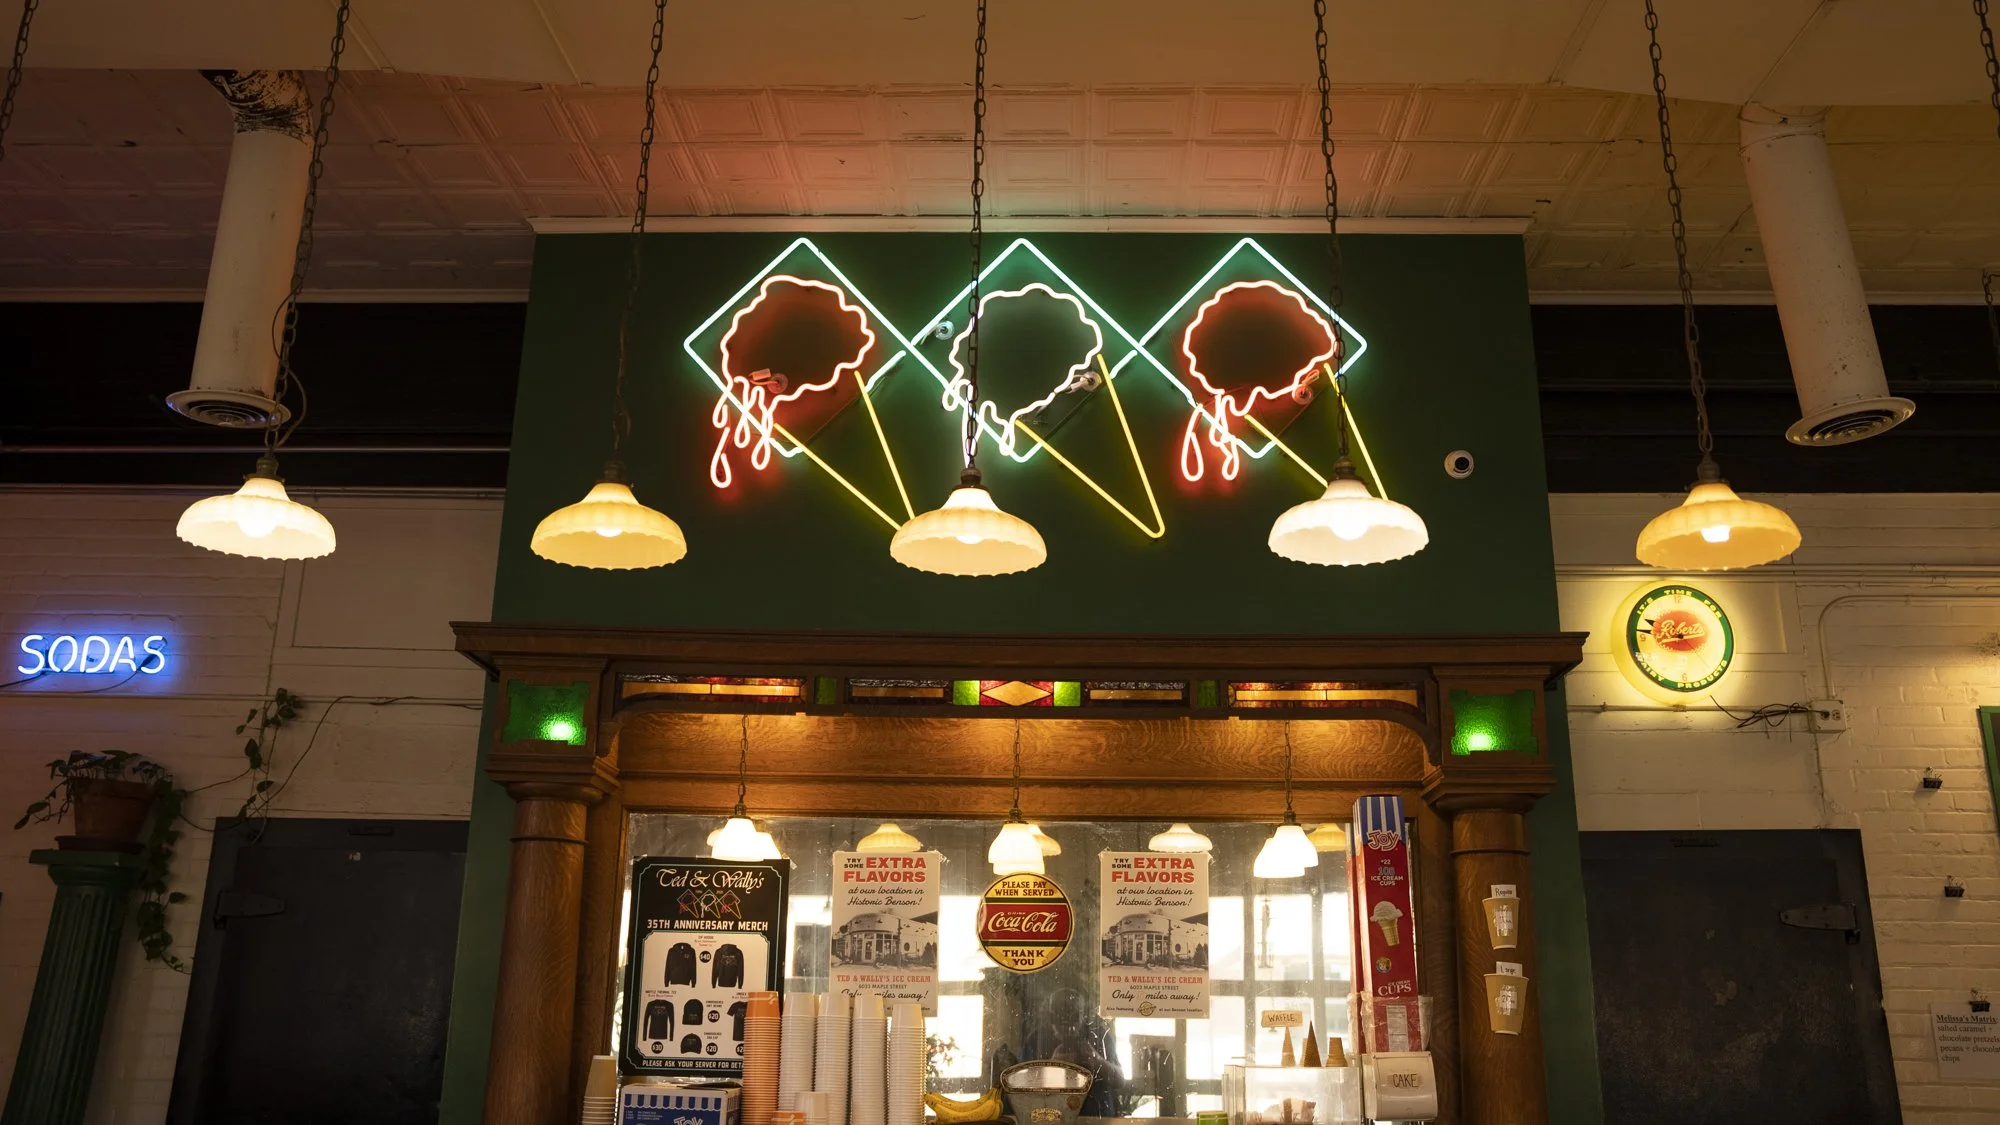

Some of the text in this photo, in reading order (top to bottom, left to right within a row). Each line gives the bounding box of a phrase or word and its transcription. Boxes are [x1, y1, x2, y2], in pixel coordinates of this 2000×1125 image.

[1636, 589, 1722, 619] IT'S TIME FOR
[1640, 634, 1647, 642] 9
[18, 634, 168, 675] SODAS
[1677, 660, 1728, 689] PRODUCTS
[866, 857, 926, 868] EXTRA
[1134, 857, 1194, 869] EXTRA
[656, 868, 764, 894] Ted & Wally's
[844, 871, 926, 882] FLAVORS
[1112, 871, 1194, 883] FLAVORS
[877, 886, 913, 894] location
[1147, 886, 1182, 895] location
[848, 896, 922, 906] Historic Benson!
[1116, 896, 1192, 906] Historic Benson!
[647, 919, 768, 931] 35TH ANNIVERSARY MERCH
[988, 911, 1060, 933] Coca-Cola
[700, 952, 711, 960] $40
[1002, 949, 1045, 957] THANK
[1013, 958, 1034, 966] YOU
[1164, 976, 1176, 984] ICE
[1378, 984, 1412, 996] CUPS
[898, 990, 928, 1001] away!
[1112, 989, 1134, 1002] Only
[1145, 991, 1167, 1000] miles
[1170, 992, 1201, 1003] away!
[708, 1012, 719, 1020] $20
[1268, 1013, 1295, 1023] WAFFLE
[1937, 1014, 1969, 1022] Melissa's
[652, 1044, 662, 1052] $30
[706, 1045, 717, 1053] $20
[1941, 1055, 1960, 1063] chips
[1392, 1073, 1419, 1088] CAKE
